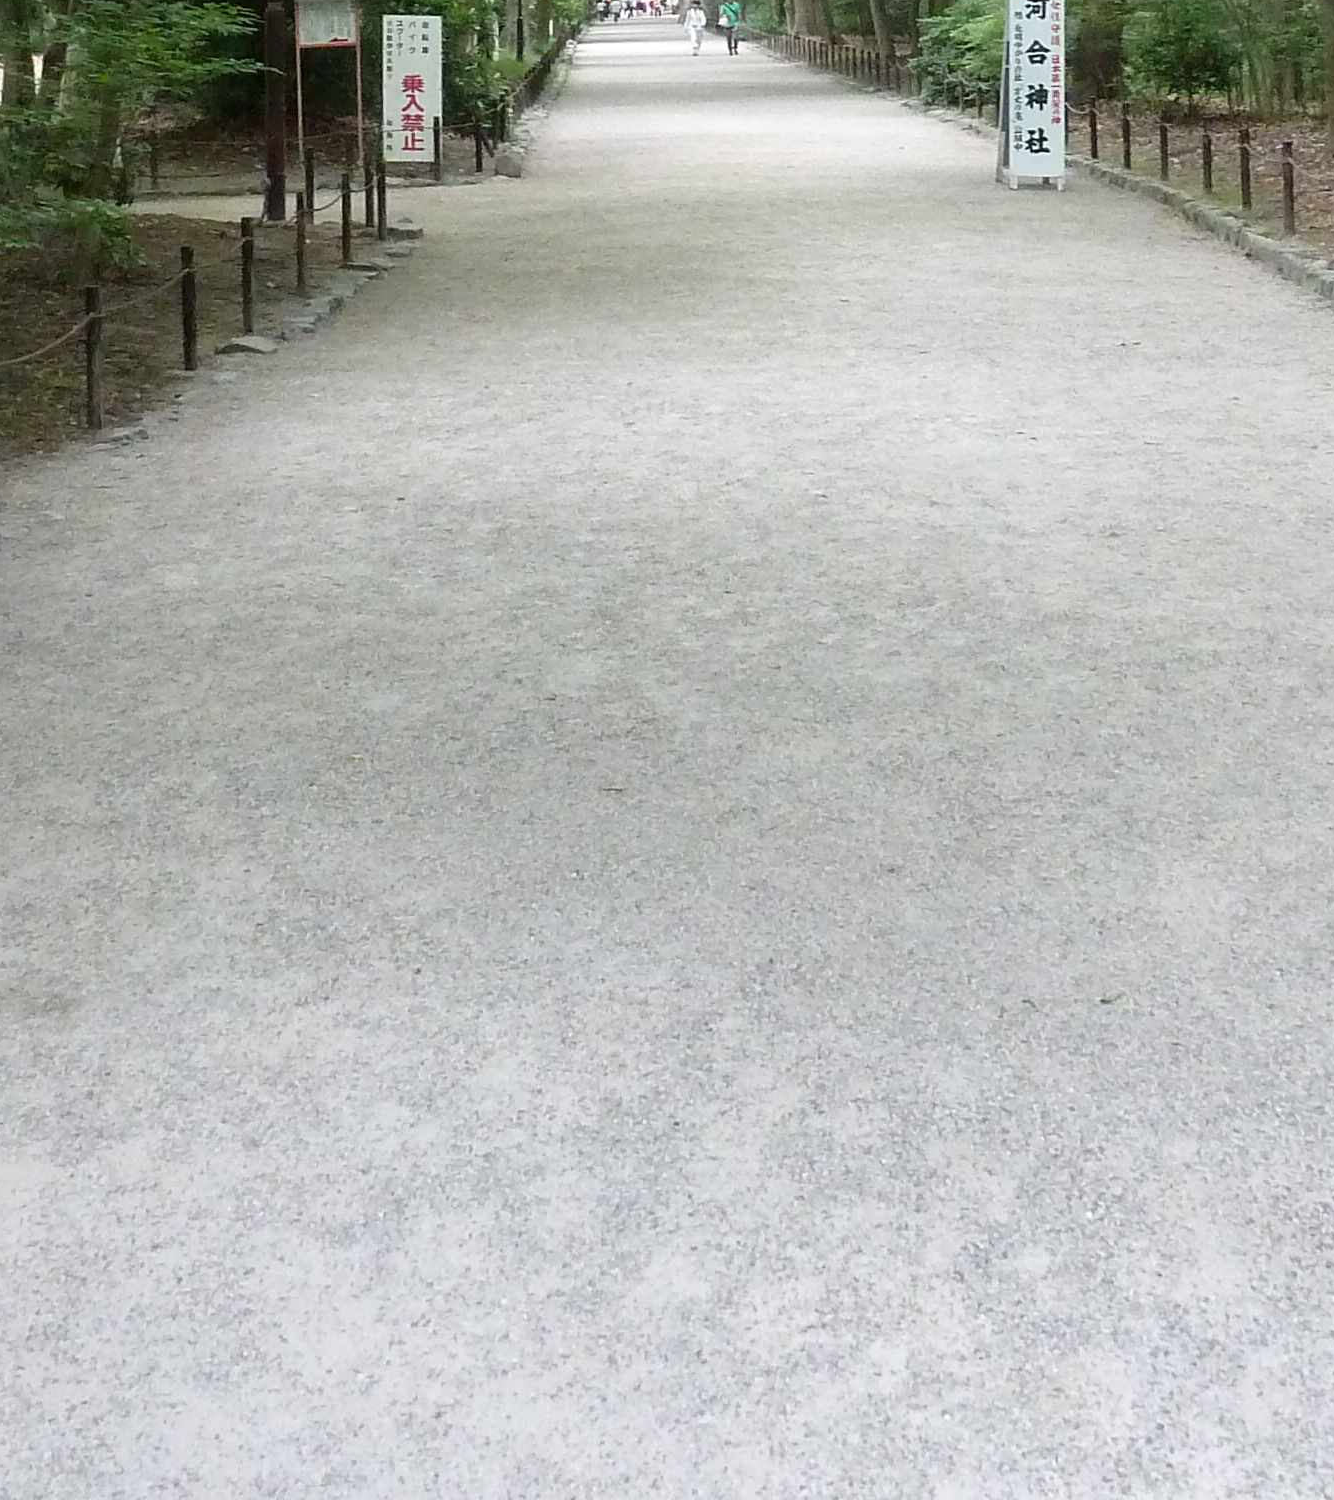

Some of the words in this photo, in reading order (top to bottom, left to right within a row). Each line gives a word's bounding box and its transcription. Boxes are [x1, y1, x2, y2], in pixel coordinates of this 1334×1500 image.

[395, 19, 405, 57] スクーター
[408, 21, 417, 54] バイク
[400, 74, 426, 151] 乗入禁止
